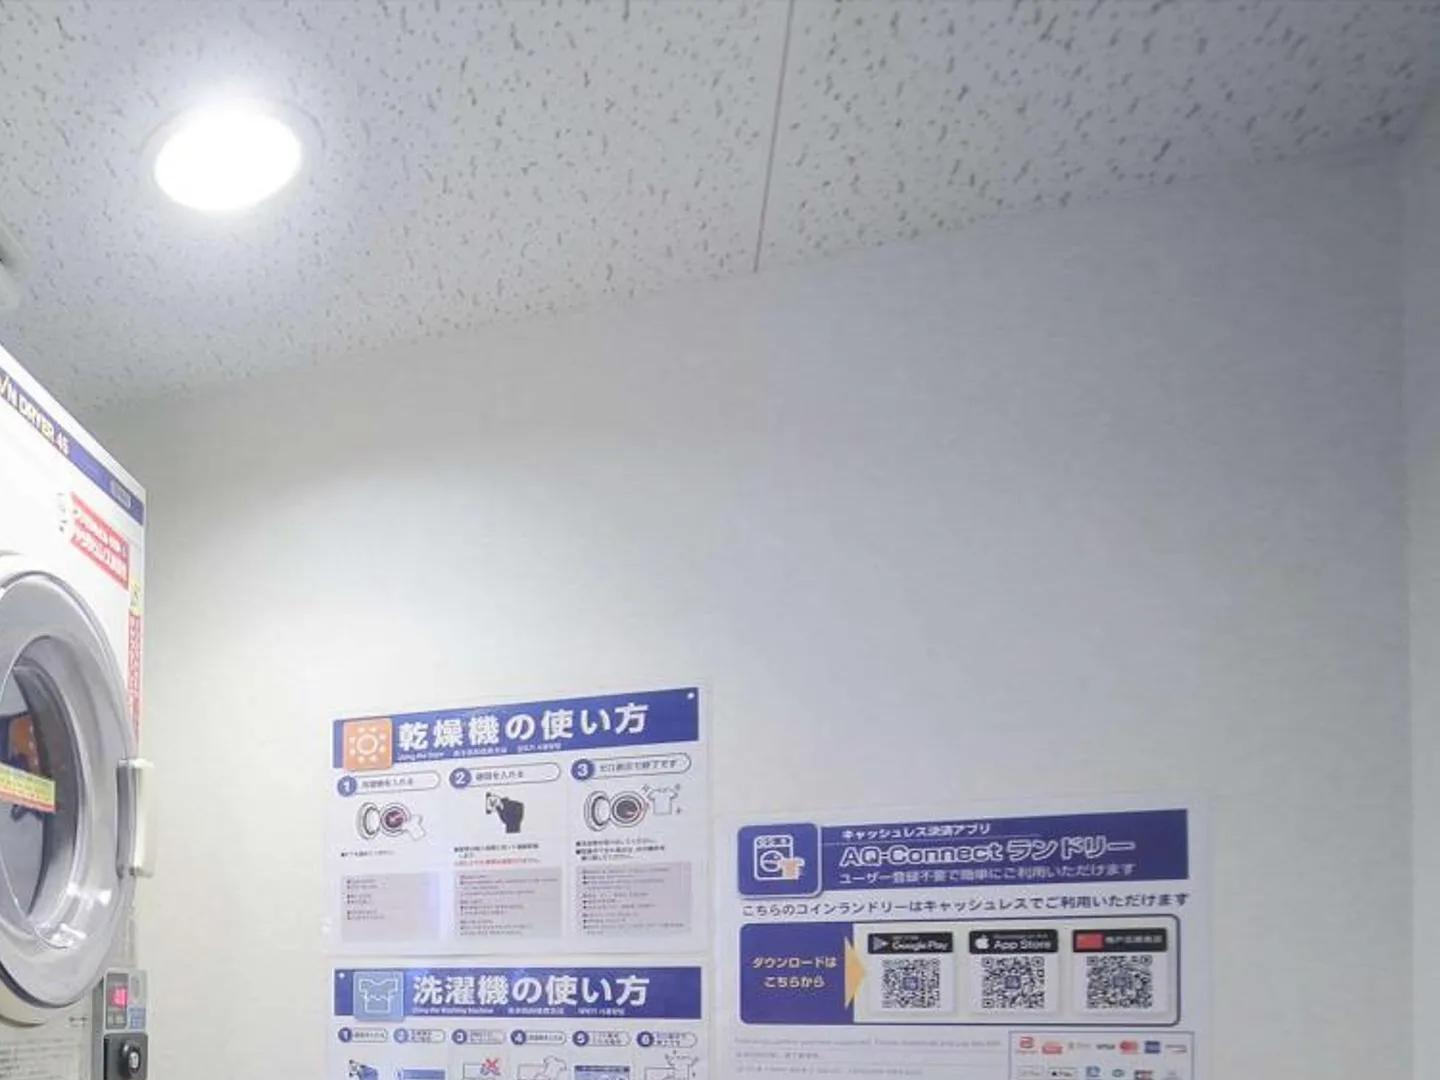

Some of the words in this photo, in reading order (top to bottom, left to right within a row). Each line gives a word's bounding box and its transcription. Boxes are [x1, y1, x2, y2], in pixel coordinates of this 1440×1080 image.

[398, 703, 648, 751] 乾燥機の使い方
[842, 823, 990, 840] キャッシュレス決済アプリ
[839, 841, 1003, 867] AQ-Connect
[1007, 836, 1136, 861] ランドリー
[840, 863, 1136, 884] ユーザー登録不要で簡単にご利用いただけます
[742, 893, 1189, 916] こちらのコインランドリーはキャッシュレスでご利用いただけます
[892, 939, 926, 951] Google
[928, 939, 949, 950] Play
[994, 939, 1018, 950] App
[1020, 938, 1051, 950] Store
[752, 956, 837, 970] ダウンロードは
[413, 975, 649, 1006] 洗濯機の使い方
[763, 975, 825, 988] こちらから
